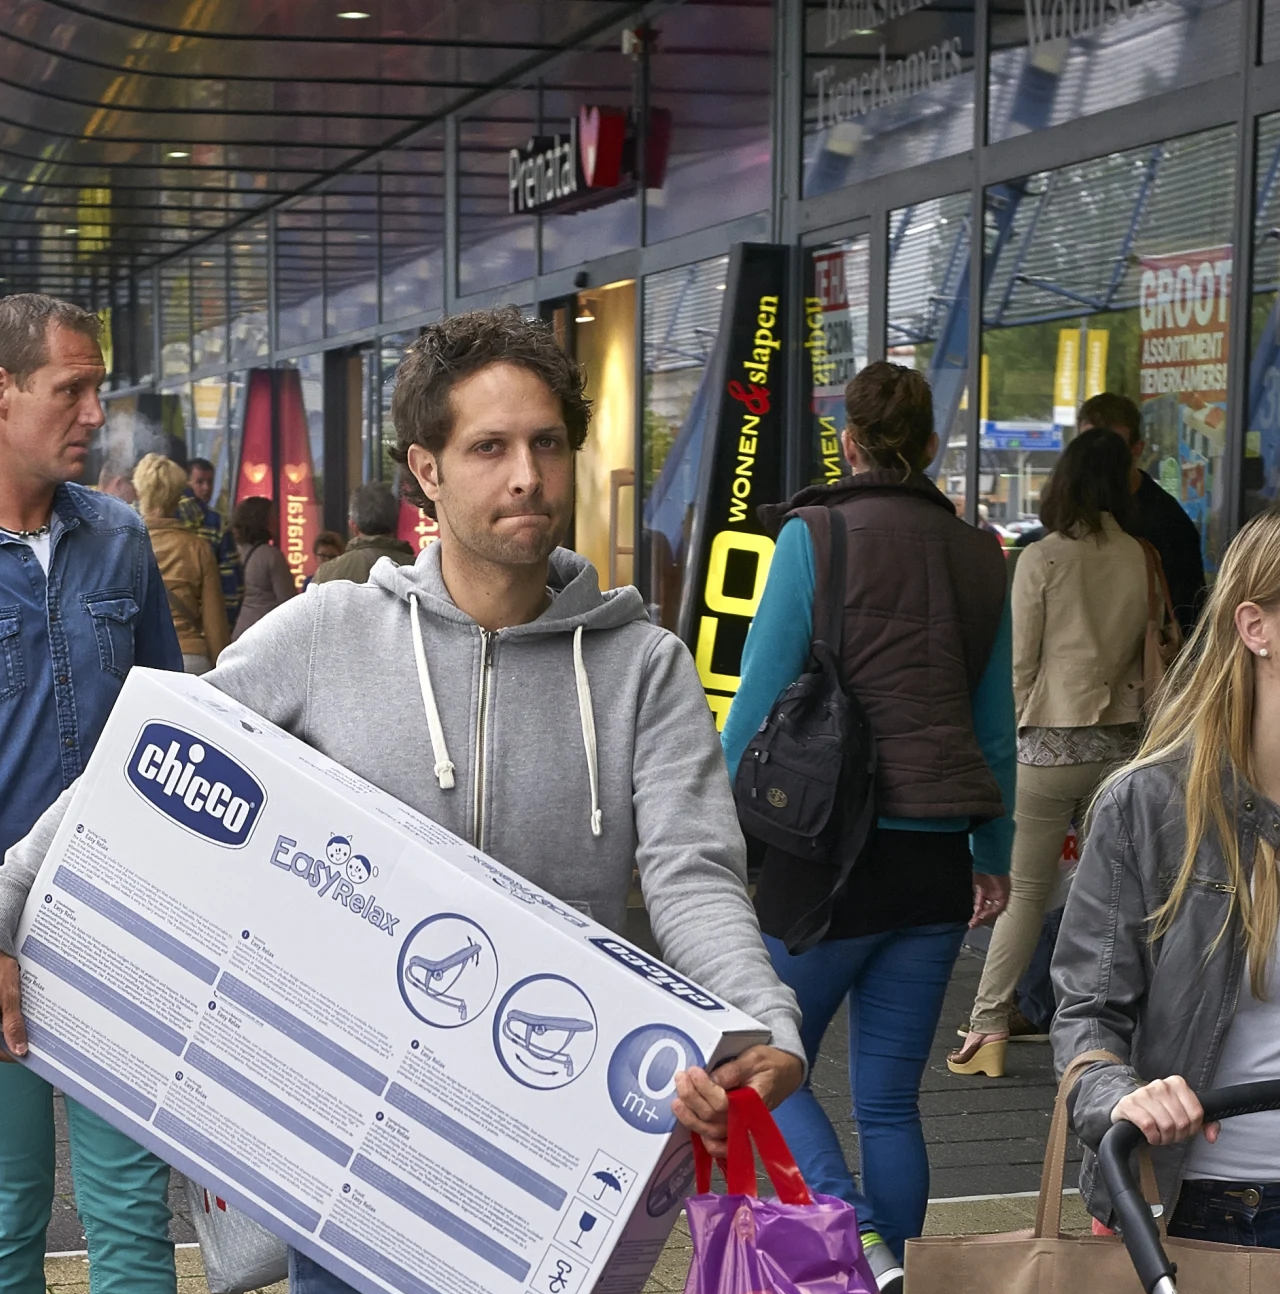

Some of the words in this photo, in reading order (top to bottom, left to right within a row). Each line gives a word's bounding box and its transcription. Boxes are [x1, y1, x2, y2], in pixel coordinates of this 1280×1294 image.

[1140, 259, 1232, 331] GROOT
[743, 294, 780, 386] slapen
[1142, 331, 1224, 365] ASSORTIMENT
[728, 380, 770, 415] &
[728, 414, 761, 523] WONEN
[136, 739, 251, 834] chicco
[83, 833, 96, 844] Easy
[95, 840, 109, 851] Relax
[52, 903, 64, 913] Easy
[63, 910, 77, 921] Relax
[249, 939, 262, 950] Easy
[260, 946, 275, 958] Relax
[31, 979, 46, 991] Relax
[602, 942, 717, 1008] chicco
[215, 1010, 228, 1021] Easy
[227, 1017, 241, 1029] Relax
[419, 1049, 432, 1060] Easy
[431, 1056, 446, 1069] Relax
[637, 1038, 687, 1099] 0
[182, 1080, 195, 1091] Easy
[194, 1087, 208, 1099] Relax
[623, 1090, 659, 1123] m+
[395, 1128, 410, 1141] Relax
[350, 1193, 362, 1204] Easy
[361, 1200, 377, 1213] Relax
